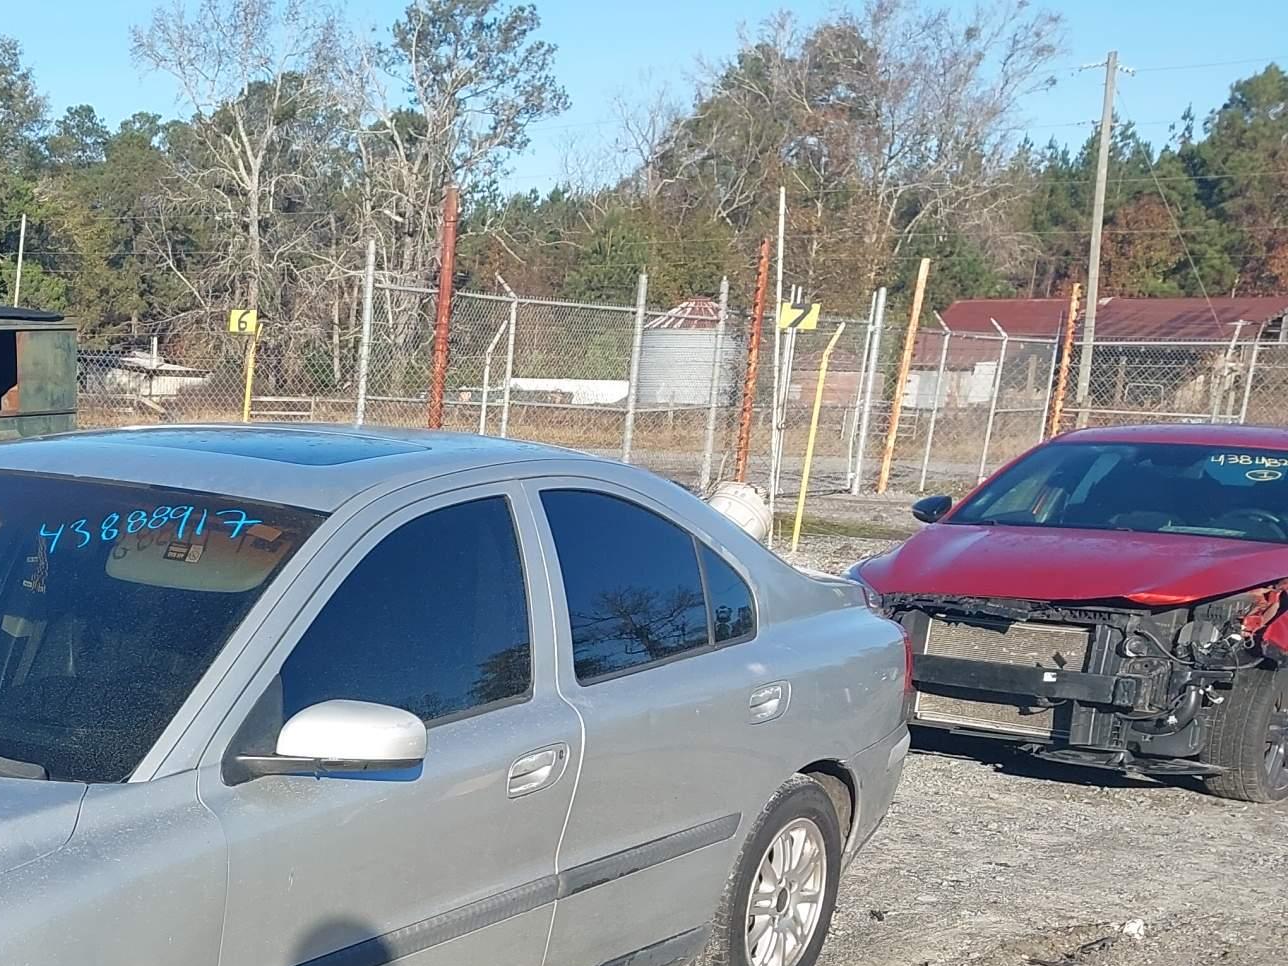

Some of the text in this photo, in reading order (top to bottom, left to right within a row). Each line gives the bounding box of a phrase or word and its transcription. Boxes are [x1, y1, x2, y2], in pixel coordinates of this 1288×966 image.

[238, 310, 251, 332] 6
[787, 302, 813, 329] 7
[39, 506, 261, 553] 43888917
